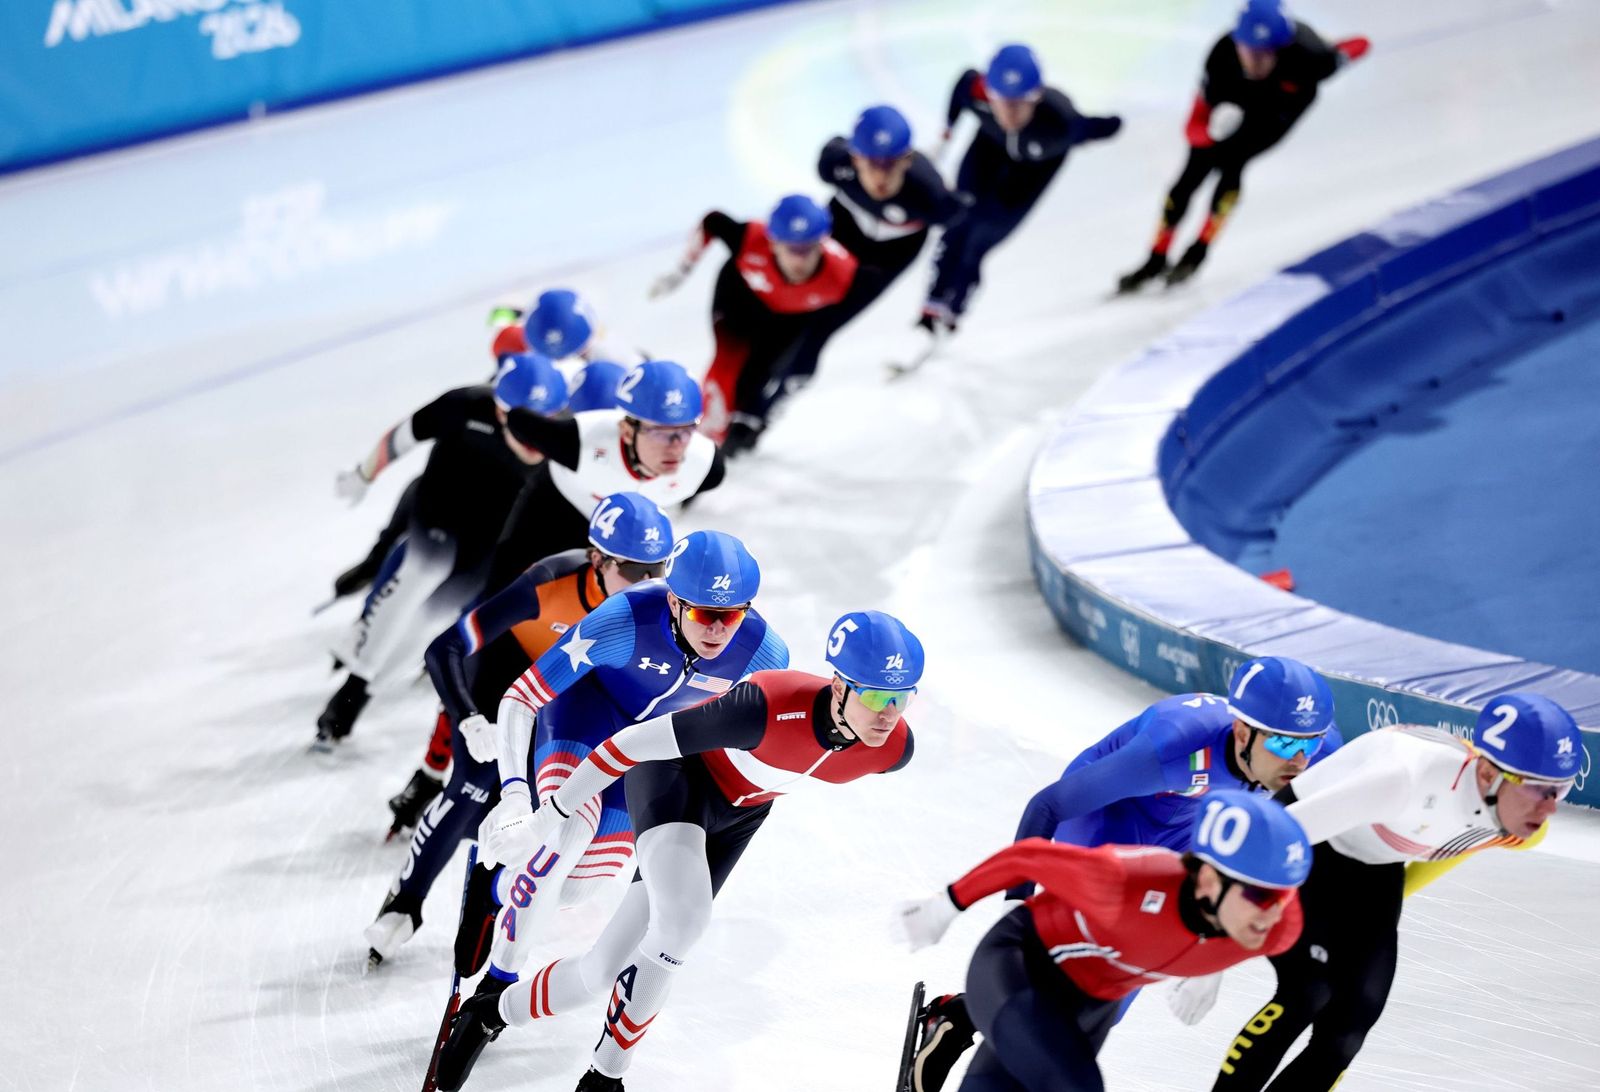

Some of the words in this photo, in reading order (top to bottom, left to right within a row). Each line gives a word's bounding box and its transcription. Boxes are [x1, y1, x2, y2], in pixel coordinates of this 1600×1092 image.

[590, 498, 624, 539] 14
[665, 538, 690, 578] 8
[828, 618, 860, 657] 5
[1234, 663, 1265, 700] 1
[1481, 704, 1518, 751] 2
[1197, 800, 1251, 857] 10
[501, 844, 560, 942] USA
